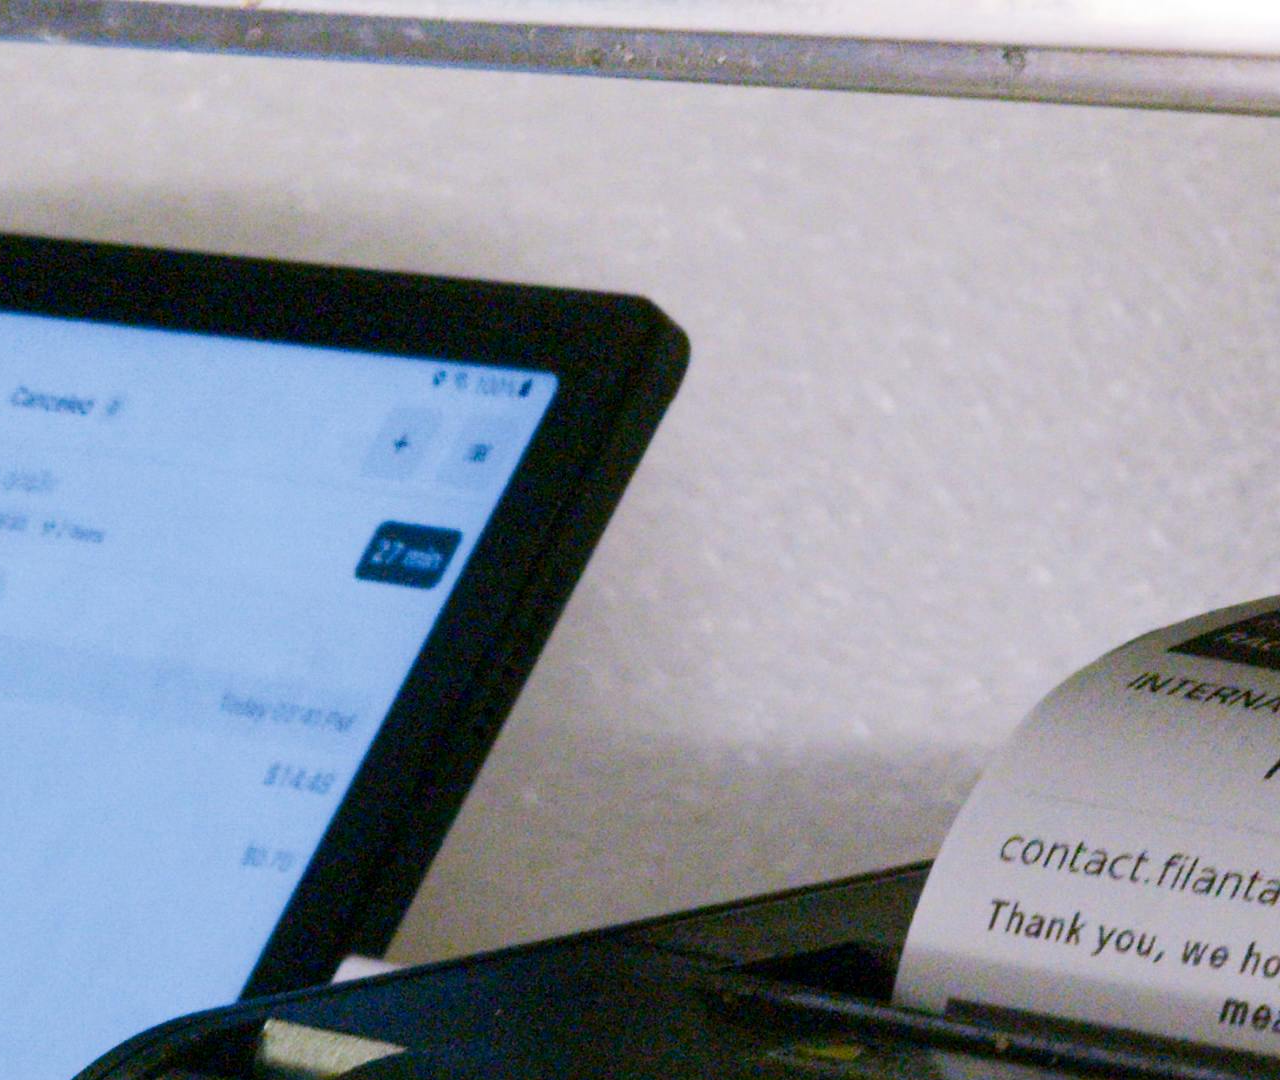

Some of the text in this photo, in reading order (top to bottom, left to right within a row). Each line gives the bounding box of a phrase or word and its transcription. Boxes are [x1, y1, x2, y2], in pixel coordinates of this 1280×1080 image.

[10, 384, 95, 416] Canceled
[373, 537, 443, 572] 27 min
[987, 898, 1086, 946] Thank
[1091, 924, 1165, 964] you,
[1181, 939, 1229, 969] we
